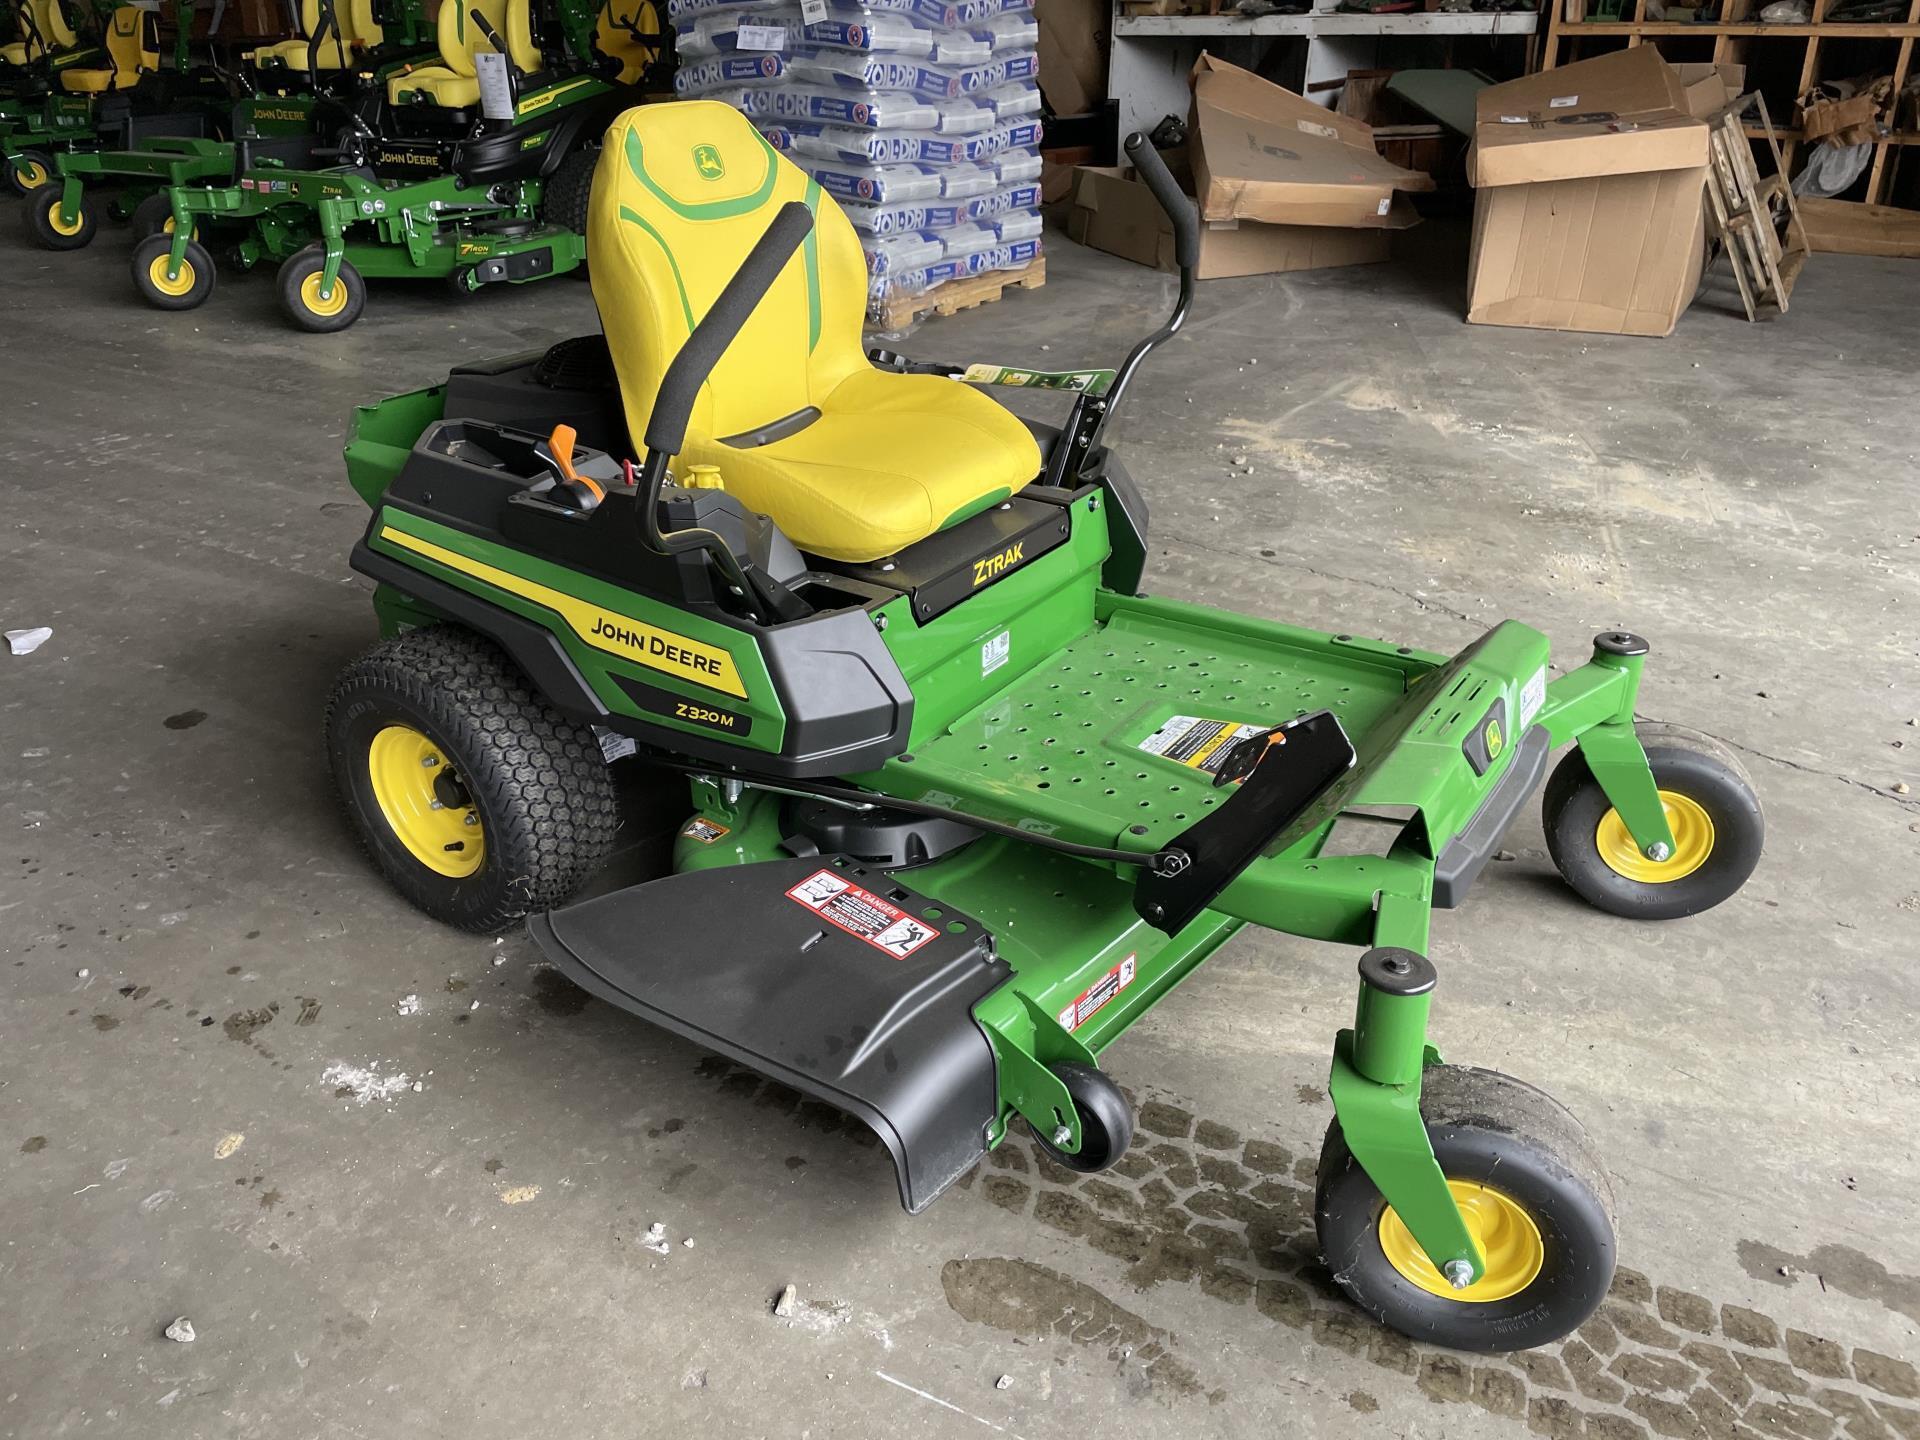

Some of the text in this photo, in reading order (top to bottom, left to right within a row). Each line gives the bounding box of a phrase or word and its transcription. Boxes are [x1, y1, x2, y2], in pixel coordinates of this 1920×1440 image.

[254, 108, 306, 121] JOHN DEERE
[380, 151, 439, 166] JOHN DEERE
[973, 541, 1024, 587] ZTRAK
[591, 617, 722, 677] JOHN DEERE
[861, 893, 899, 917] DANGER
